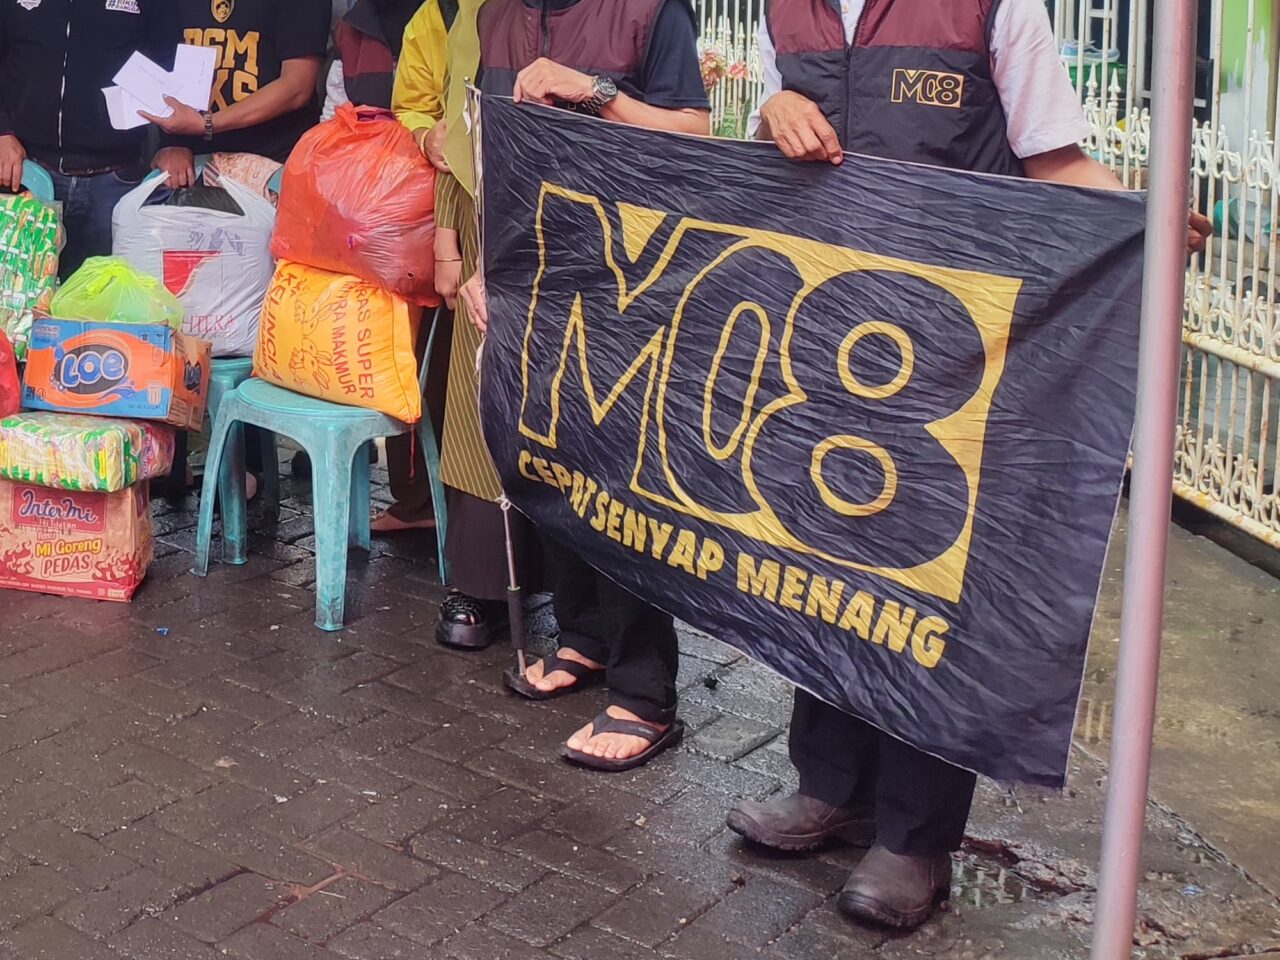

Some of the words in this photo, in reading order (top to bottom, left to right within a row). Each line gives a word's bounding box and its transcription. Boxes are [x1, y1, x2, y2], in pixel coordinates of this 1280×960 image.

[331, 325, 358, 396] MAKMUR
[357, 328, 375, 399] SUPER
[42, 554, 93, 577] PEDAS
[56, 538, 102, 555] Goreng
[517, 449, 593, 520] CEPAT
[589, 490, 724, 583] SENYAP
[734, 553, 951, 670] MENANG
